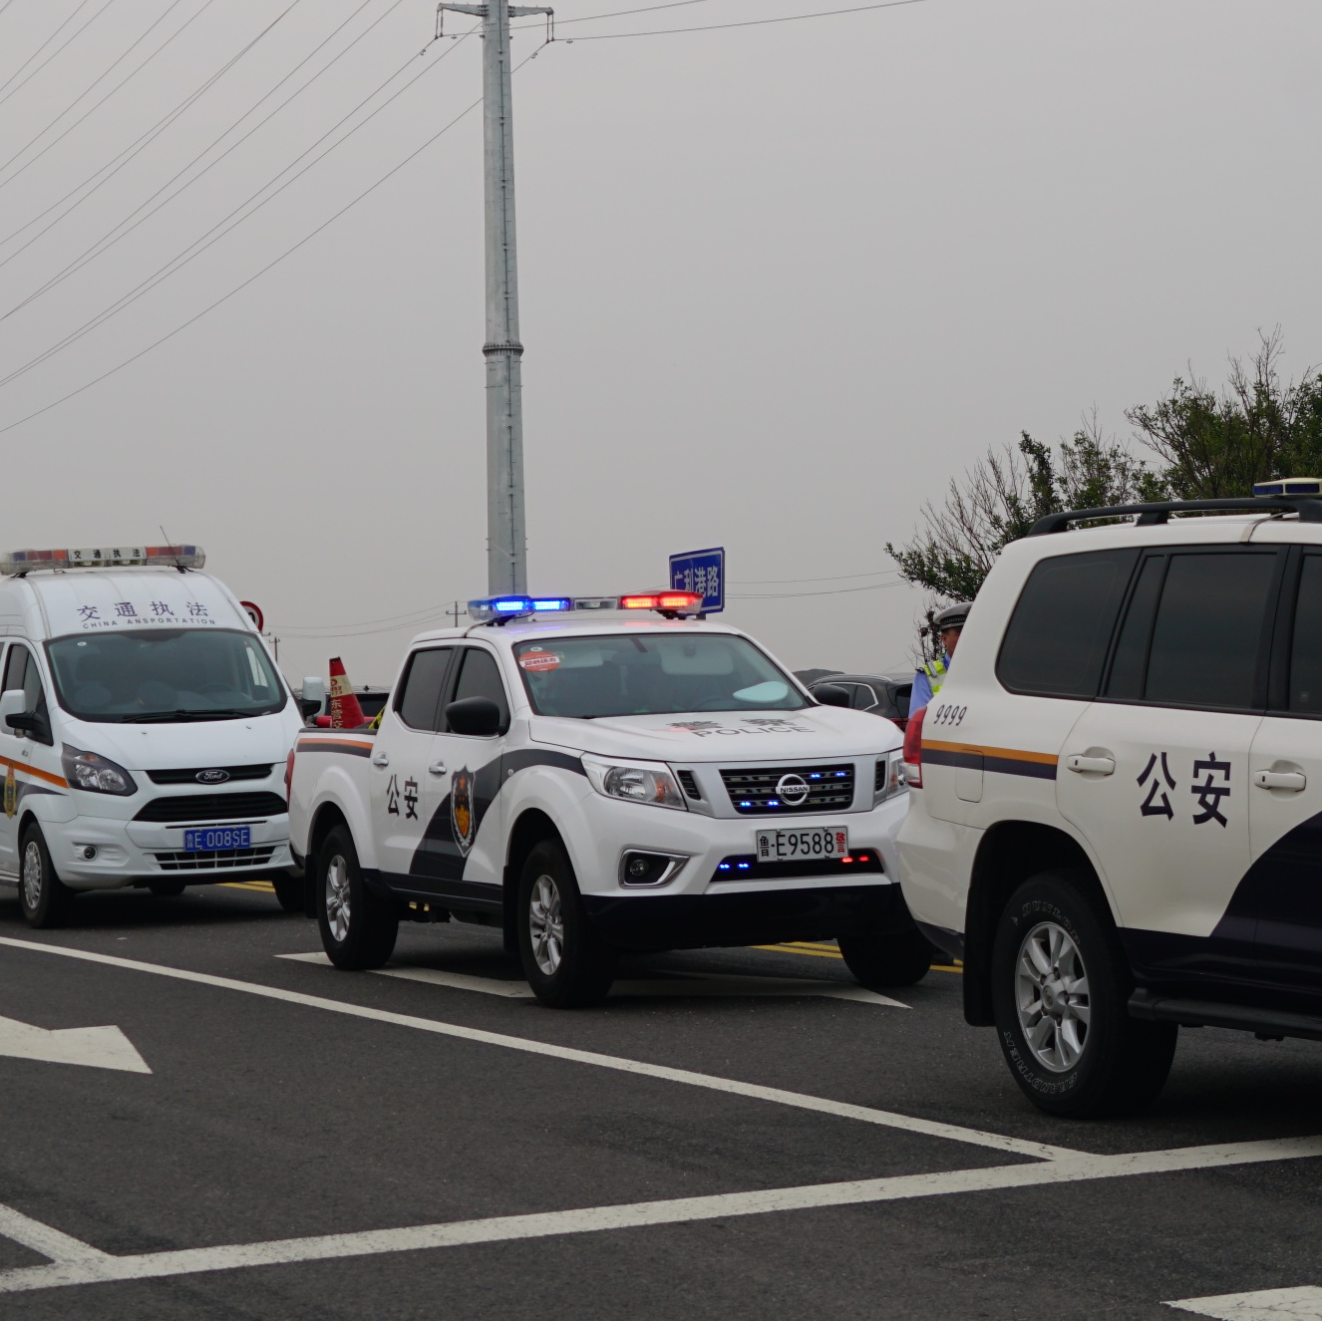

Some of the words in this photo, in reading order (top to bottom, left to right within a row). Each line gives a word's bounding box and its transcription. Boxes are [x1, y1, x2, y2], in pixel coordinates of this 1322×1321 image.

[74, 548, 140, 559] 交通执法
[674, 565, 719, 598] 广利港路
[76, 601, 209, 622] 交通执法
[82, 619, 118, 629] CHINA
[933, 704, 967, 726] 9999
[691, 726, 816, 738] POLICE
[386, 773, 419, 821] 公安
[1136, 751, 1232, 829] 公安
